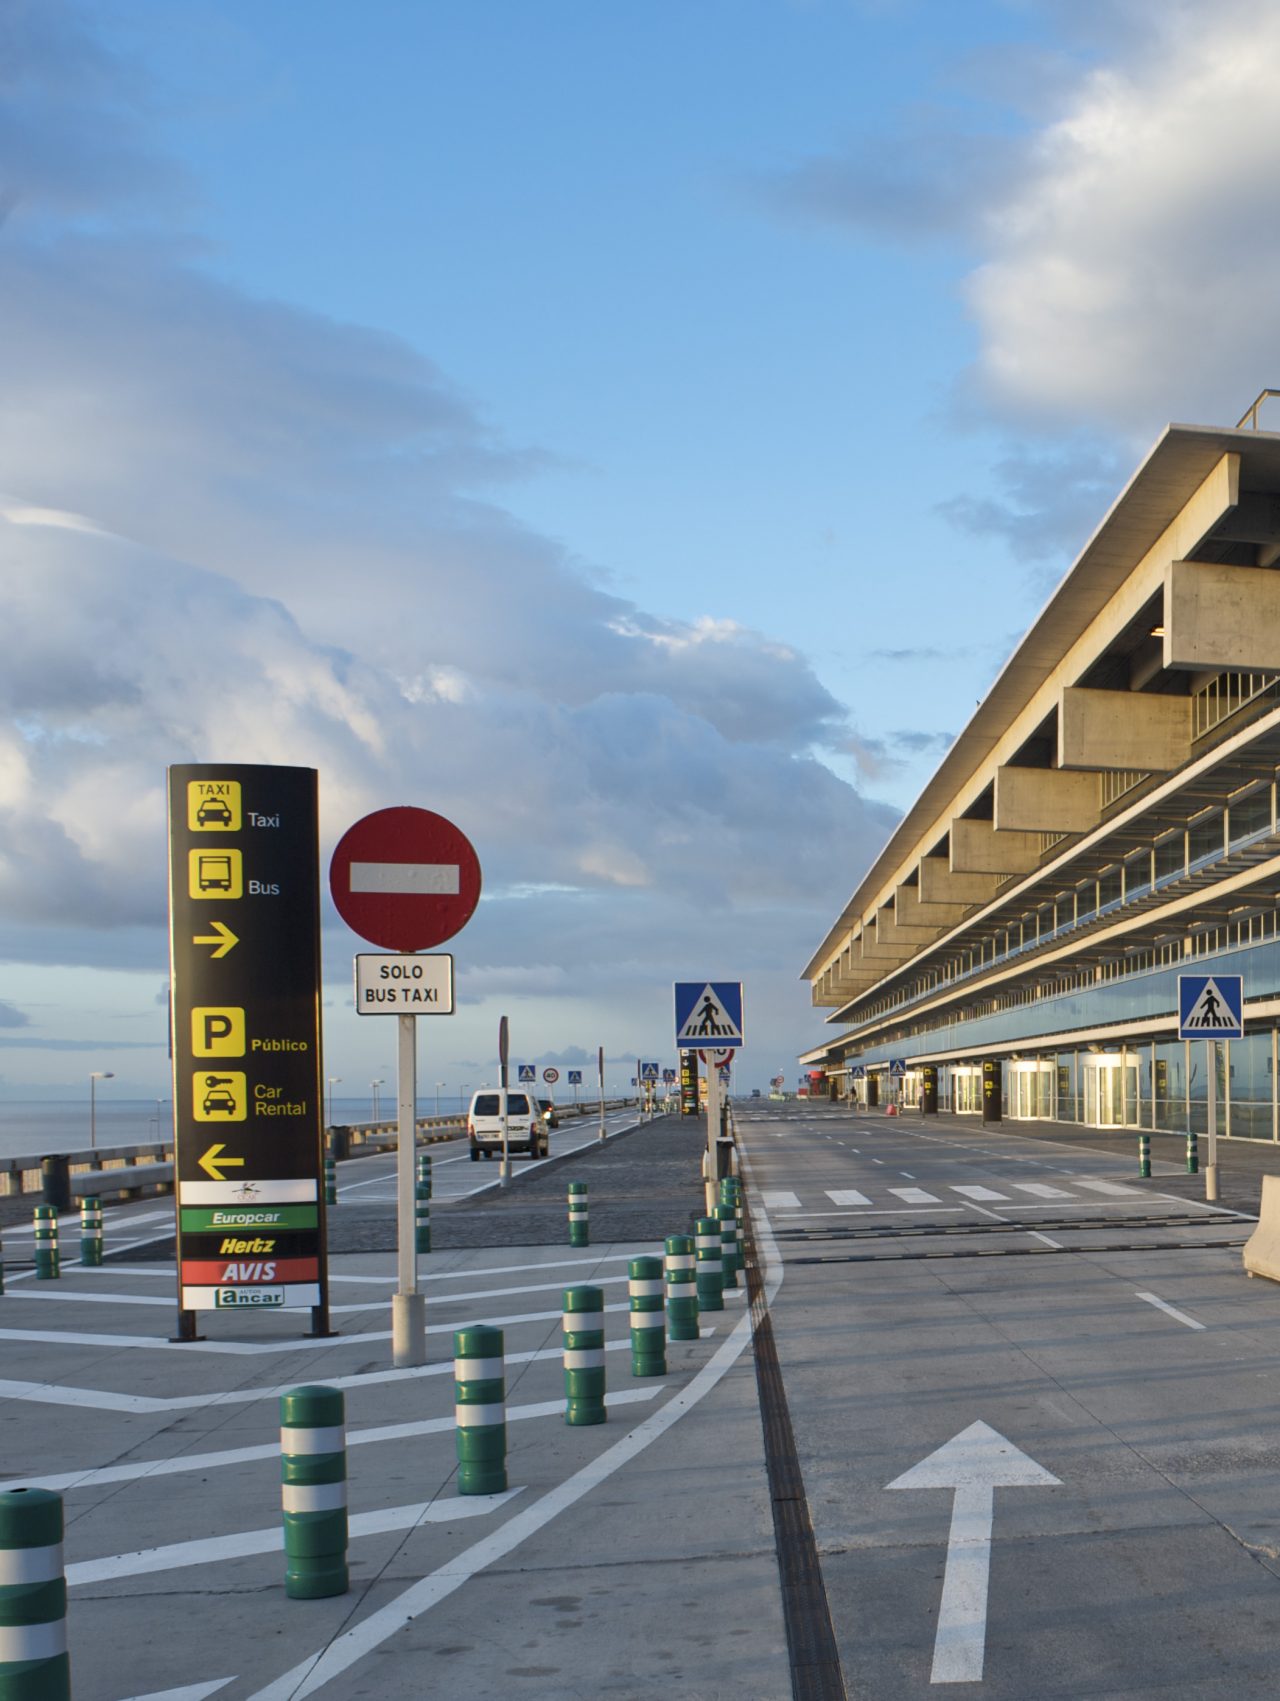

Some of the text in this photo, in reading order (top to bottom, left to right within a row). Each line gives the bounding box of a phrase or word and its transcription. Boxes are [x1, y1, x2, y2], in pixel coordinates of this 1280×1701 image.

[198, 784, 230, 795] TAXI
[248, 812, 280, 828] Taxi
[248, 880, 280, 895] Bus
[380, 965, 423, 979] SOLO
[365, 988, 438, 1002] BUS TAXI
[204, 1015, 233, 1050] P
[251, 1038, 308, 1051] Público
[254, 1084, 283, 1099] Car
[255, 1101, 306, 1116] Rental
[212, 1212, 280, 1225] Europcar
[219, 1237, 276, 1254] Hertz
[221, 1262, 277, 1281] AVIS
[222, 1290, 281, 1304] ancar
